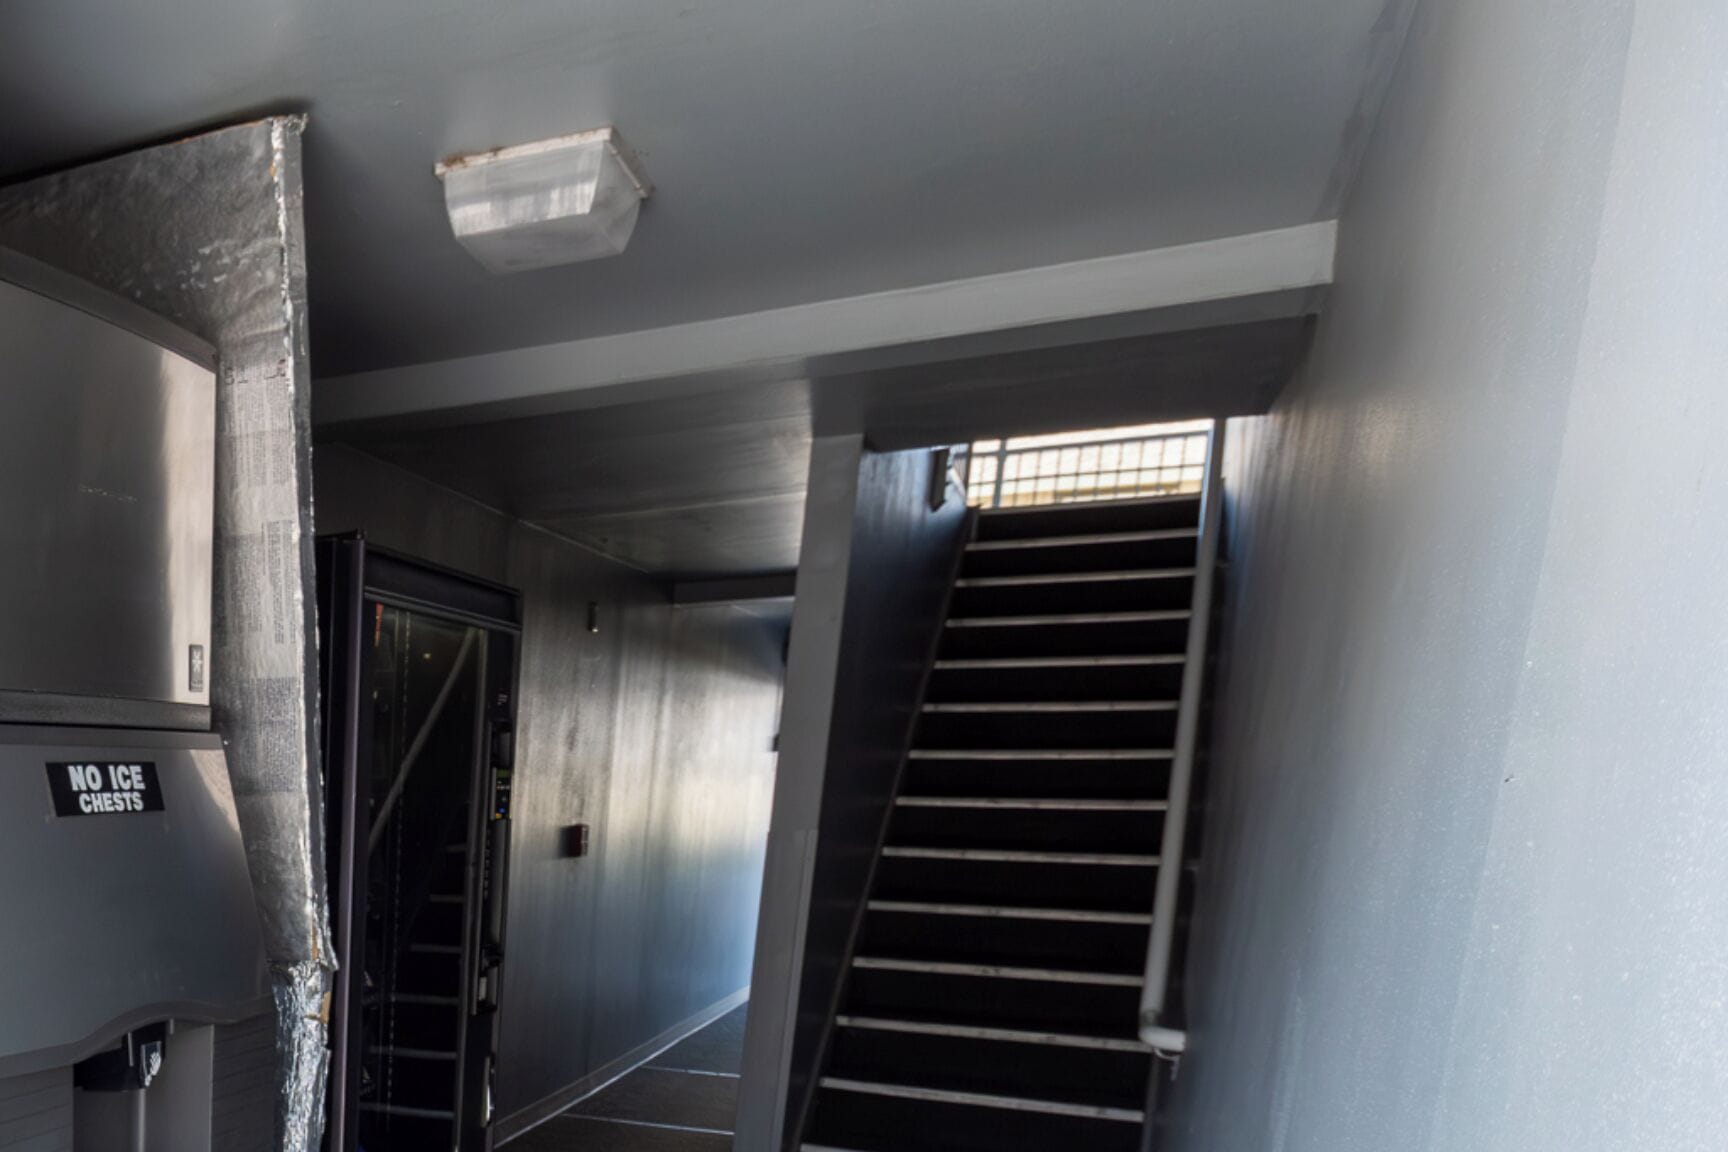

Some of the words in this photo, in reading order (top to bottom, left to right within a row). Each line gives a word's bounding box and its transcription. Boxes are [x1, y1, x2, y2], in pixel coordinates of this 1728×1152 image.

[67, 764, 103, 791] NO
[108, 764, 146, 791] ICE
[79, 792, 144, 814] CHESTS
